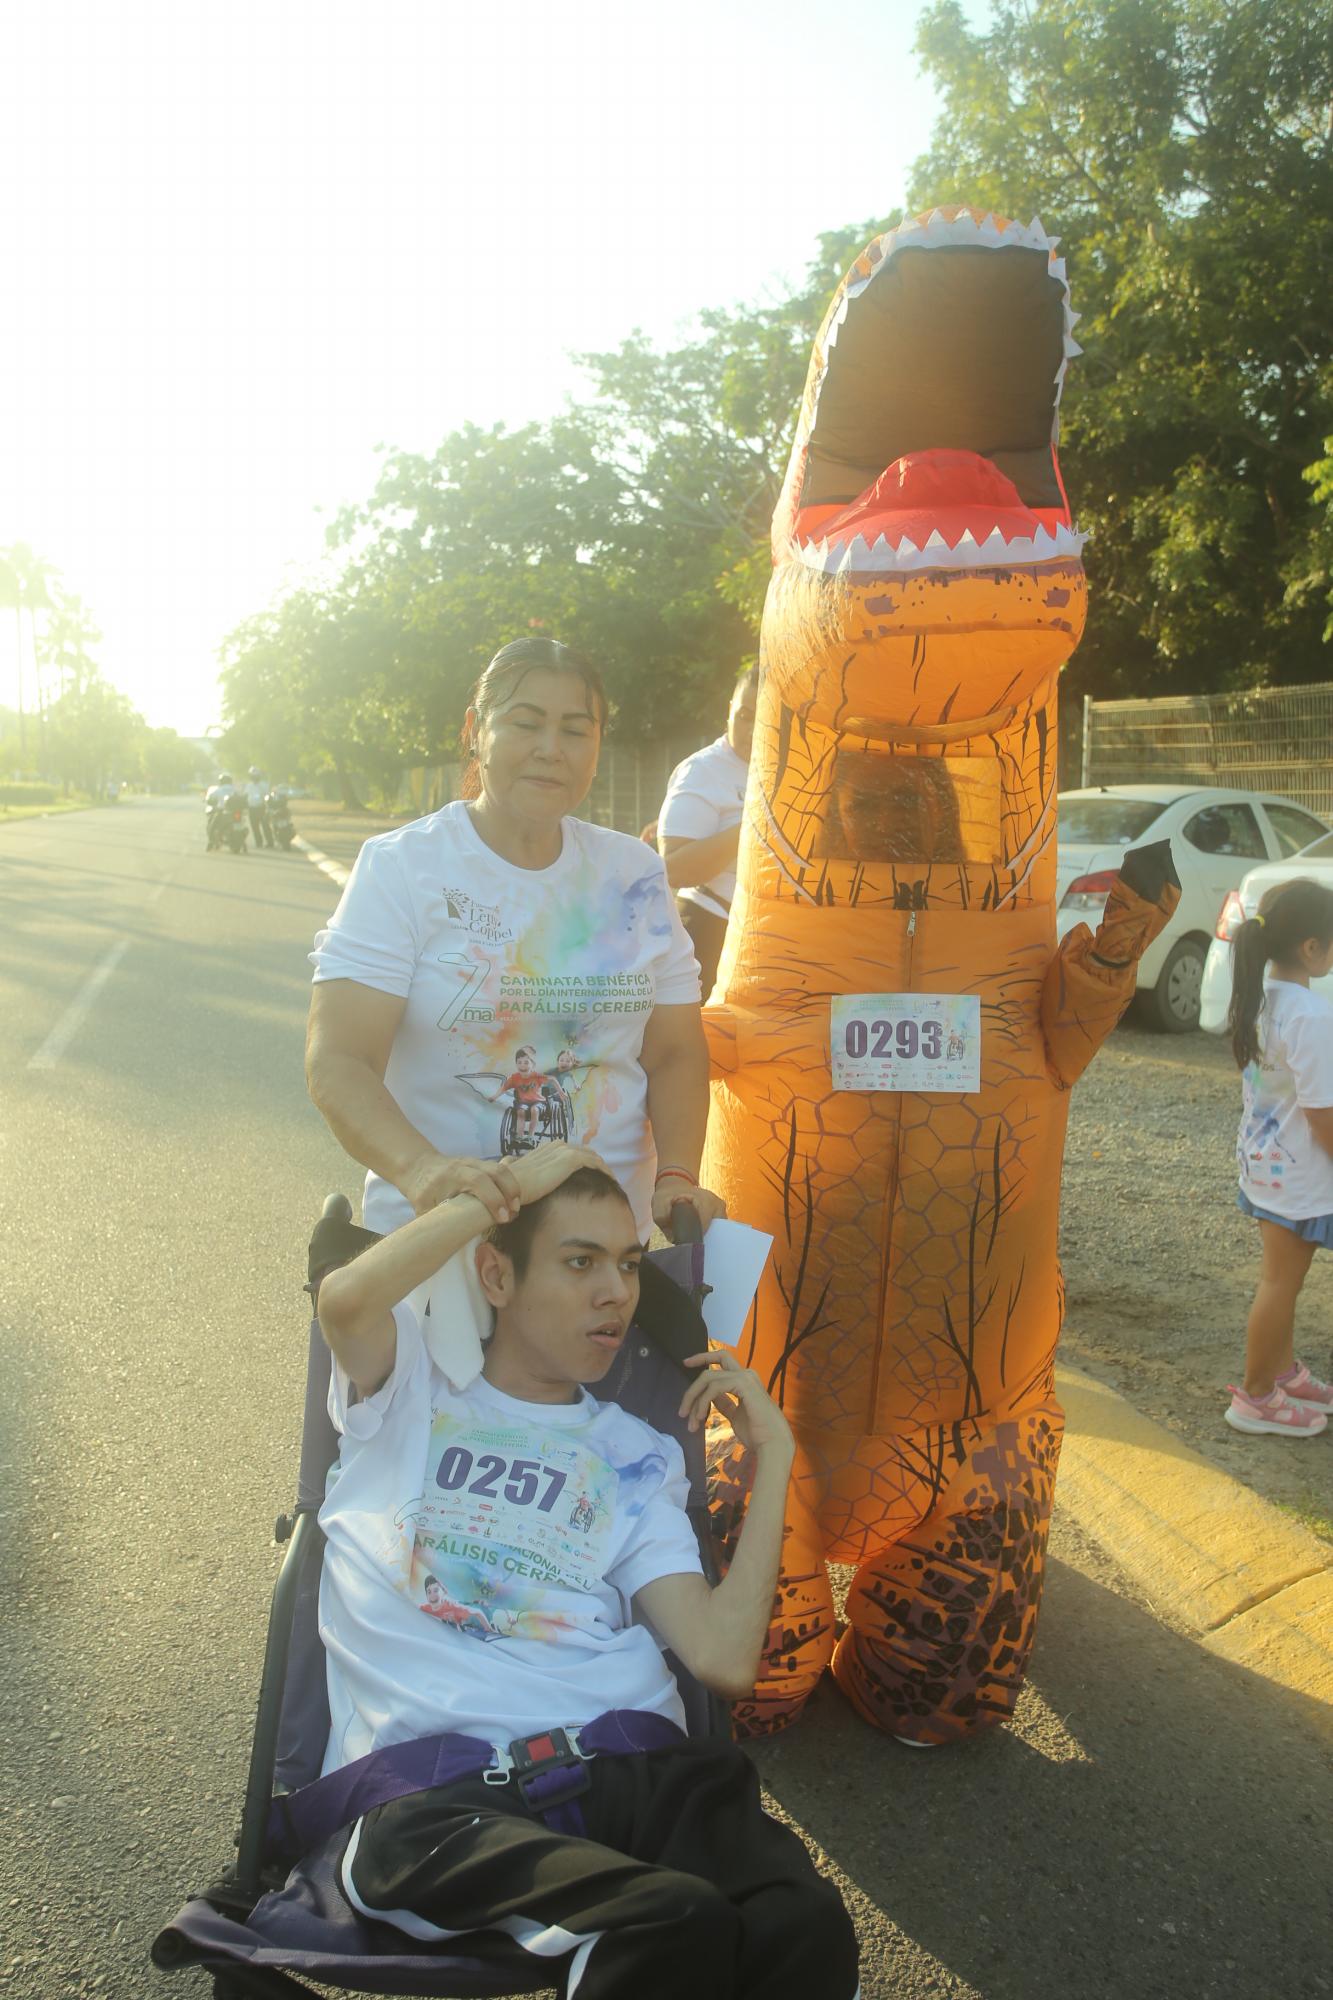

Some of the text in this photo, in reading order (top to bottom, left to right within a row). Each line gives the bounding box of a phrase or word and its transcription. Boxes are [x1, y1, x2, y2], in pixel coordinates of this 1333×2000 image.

[469, 921, 512, 942] Coppel
[500, 971, 651, 987] CAMINATA BENÉFICA
[500, 988, 523, 997] POR
[524, 988, 536, 997] EL
[538, 985, 557, 997] DÍA
[557, 988, 636, 998] INTERNACIONAL
[500, 998, 588, 1014] PARÁLISIS
[845, 1019, 943, 1060] 0293
[435, 1445, 568, 1513] 0257
[414, 1534, 498, 1566] ARÁLISIS
